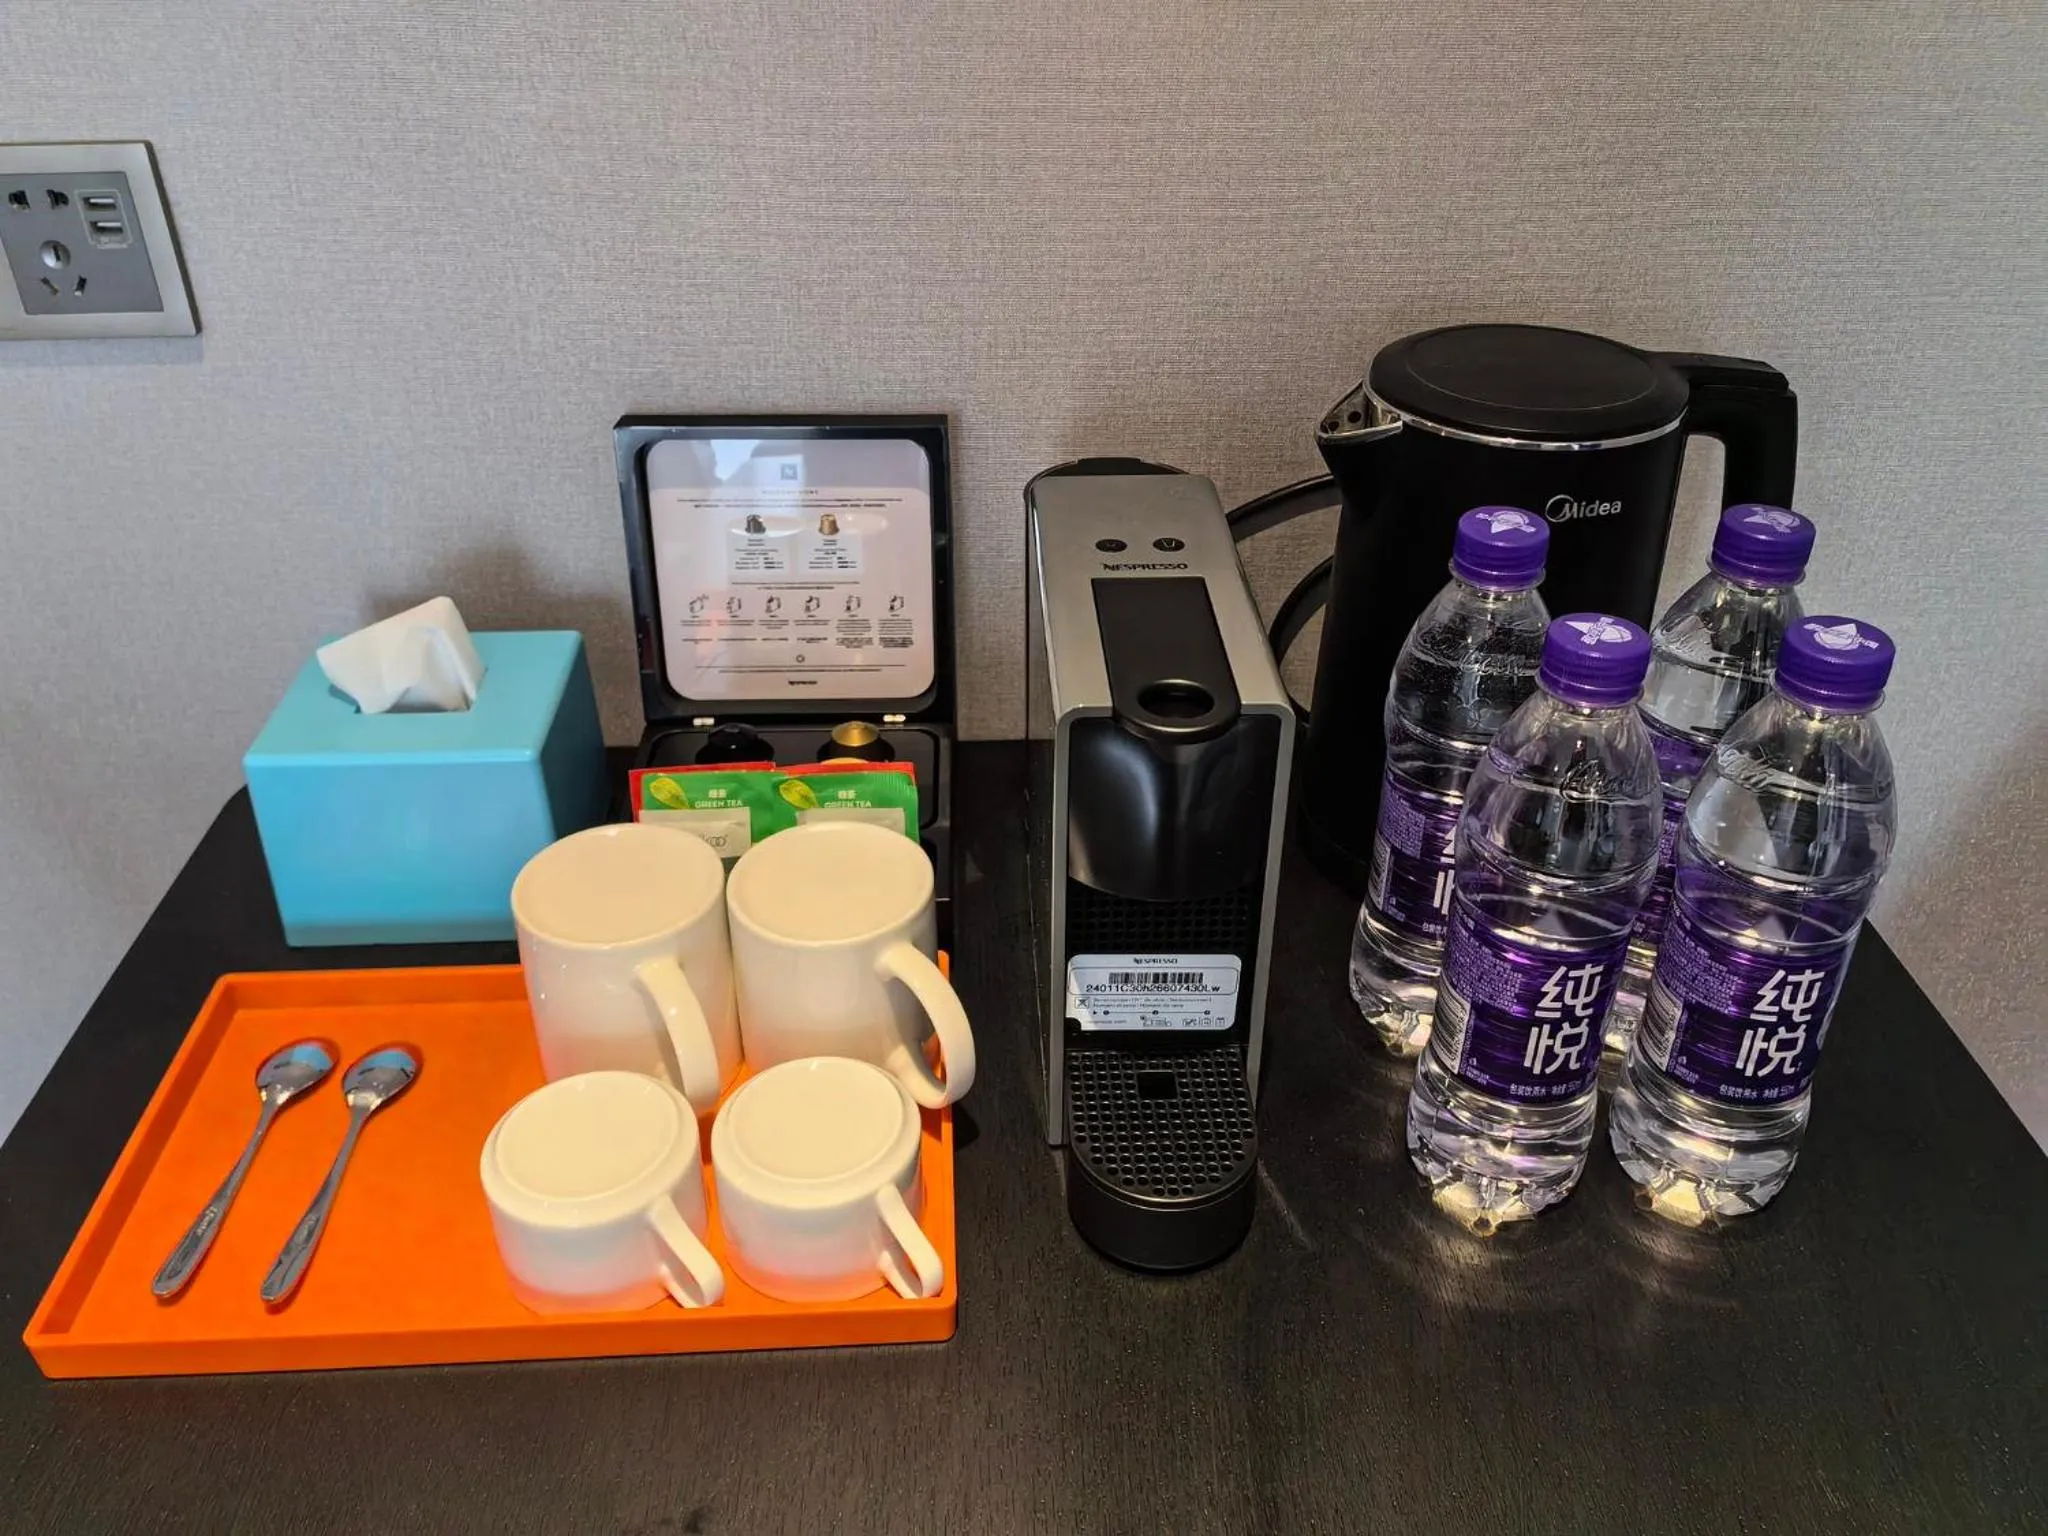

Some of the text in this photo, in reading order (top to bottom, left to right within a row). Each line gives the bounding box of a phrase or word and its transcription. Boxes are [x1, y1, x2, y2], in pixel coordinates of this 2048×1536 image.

[1545, 494, 1621, 522] Midea
[1103, 563, 1188, 571] NESPRESSO
[695, 799, 743, 808] GREEN TEA
[1523, 963, 1604, 1074] 纯悦
[1735, 969, 1825, 1077] 纯悦
